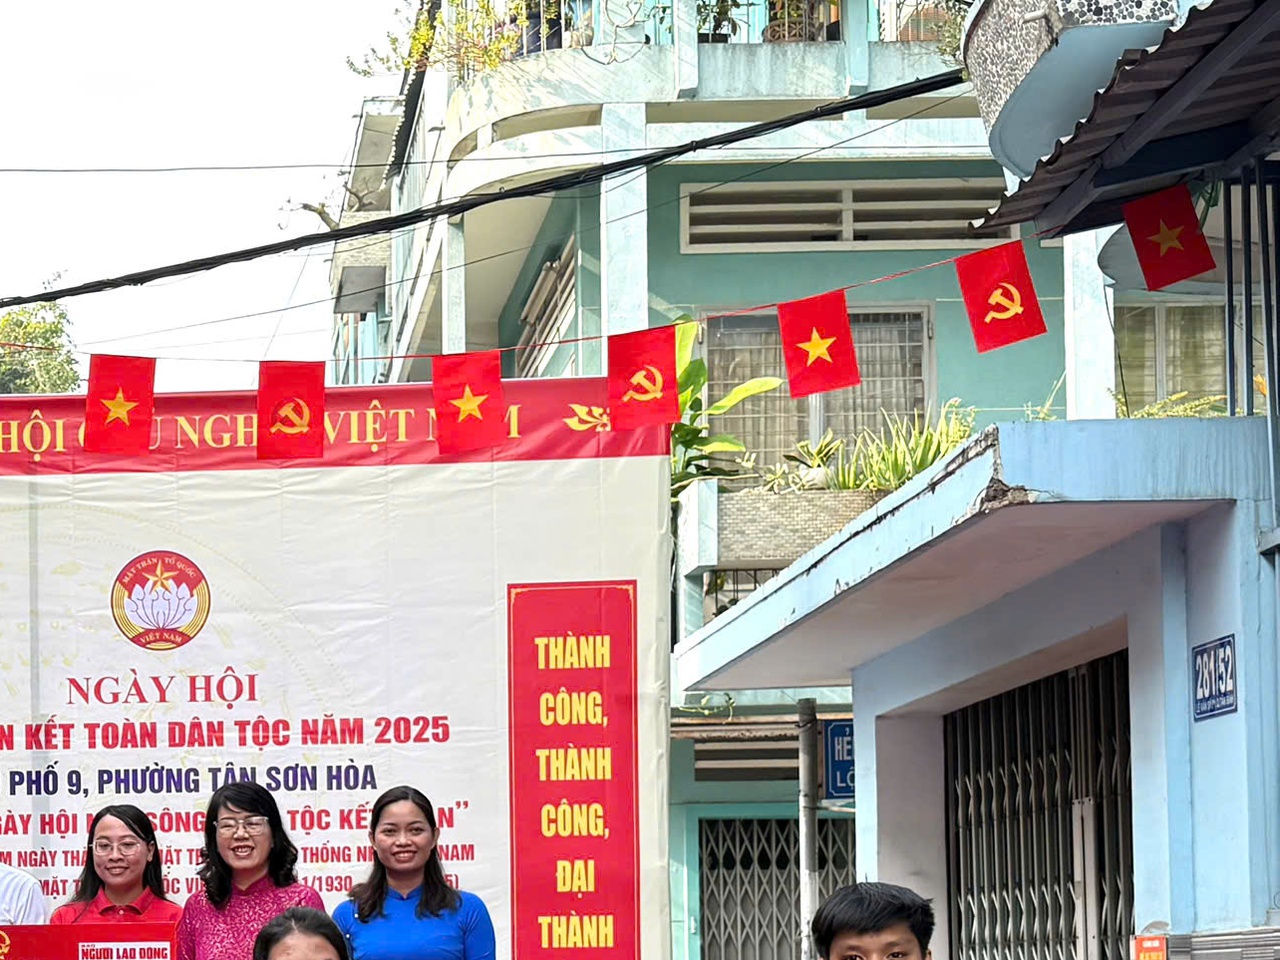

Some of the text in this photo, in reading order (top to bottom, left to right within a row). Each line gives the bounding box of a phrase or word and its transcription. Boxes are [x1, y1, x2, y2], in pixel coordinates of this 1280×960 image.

[174, 415, 258, 449] NGH
[324, 399, 415, 453] VIỆT
[535, 632, 611, 670] THÀNH
[66, 666, 259, 710] NGÀY HỘI
[1196, 644, 1233, 700] 281/52
[539, 687, 608, 728] CÔNG,
[24, 714, 75, 751] KẾT
[83, 718, 157, 749] TOÀN
[168, 717, 225, 748] DÂN
[234, 715, 291, 751] TỘC
[301, 714, 364, 746] NĂM
[374, 715, 451, 744] 2025
[834, 727, 853, 760] HẺ
[9, 760, 60, 796] PHỐ
[67, 770, 89, 798] 9,
[97, 762, 201, 796] PHƯỜNG
[208, 762, 258, 790] TÂN
[265, 763, 318, 791] SƠN
[326, 759, 378, 790] HÒA
[536, 743, 612, 781] THÀNH
[39, 808, 78, 839] HỘI
[147, 807, 207, 833] SÔNG
[287, 801, 374, 835] TỘC KẾ
[541, 799, 610, 840] CÔNG,
[17, 846, 58, 868] NGÀY
[62, 846, 88, 867] THÀ
[301, 840, 352, 863] THỐNG
[438, 844, 475, 861] NAM
[556, 860, 595, 898] ĐẠI
[538, 911, 614, 949] THÀNH
[116, 948, 137, 960] LAO
